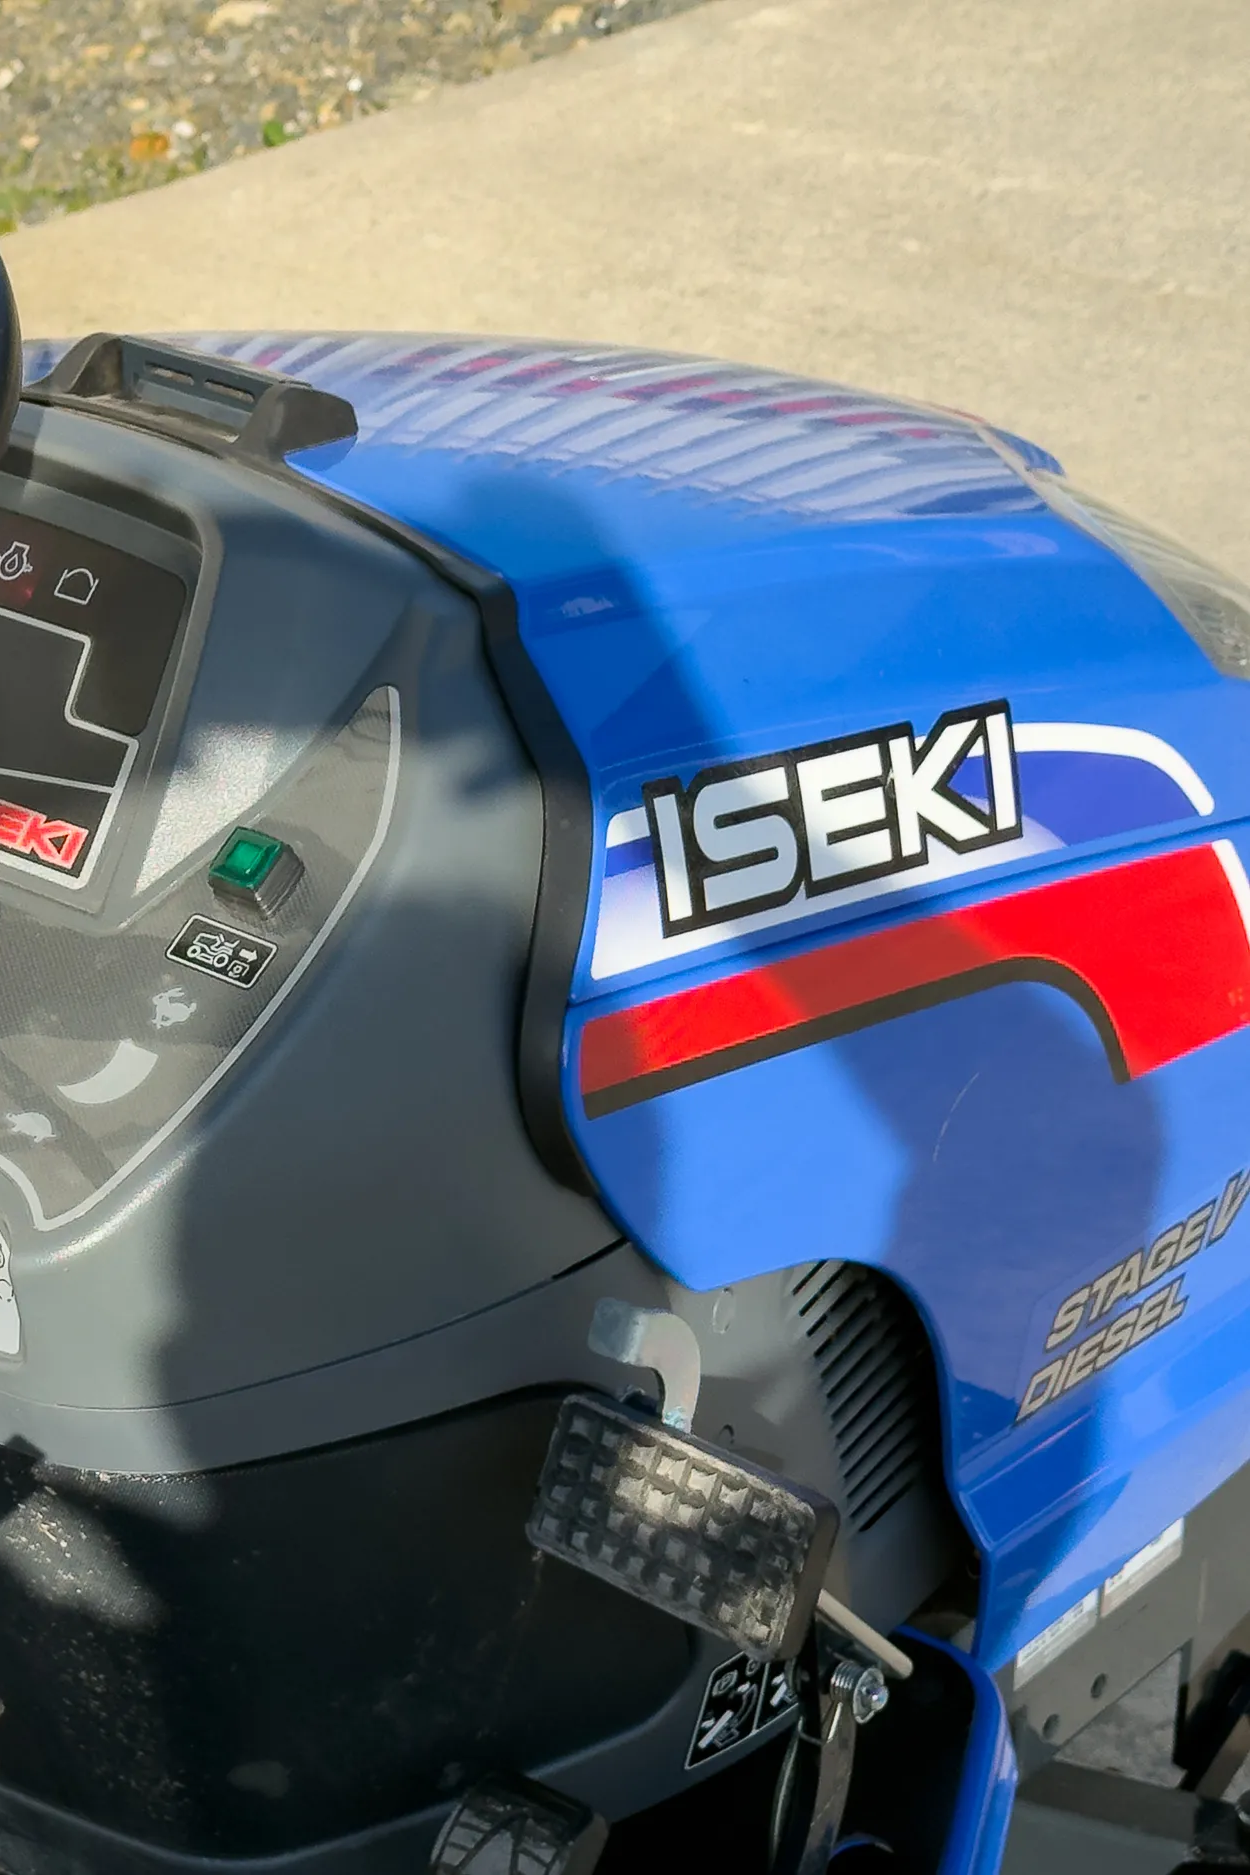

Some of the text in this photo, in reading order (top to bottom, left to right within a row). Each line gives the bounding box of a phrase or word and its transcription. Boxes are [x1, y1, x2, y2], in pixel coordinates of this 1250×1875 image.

[644, 698, 1021, 937] ISEKI
[1012, 1273, 1189, 1427] DIESEL
[1045, 1197, 1217, 1352] STAGE
